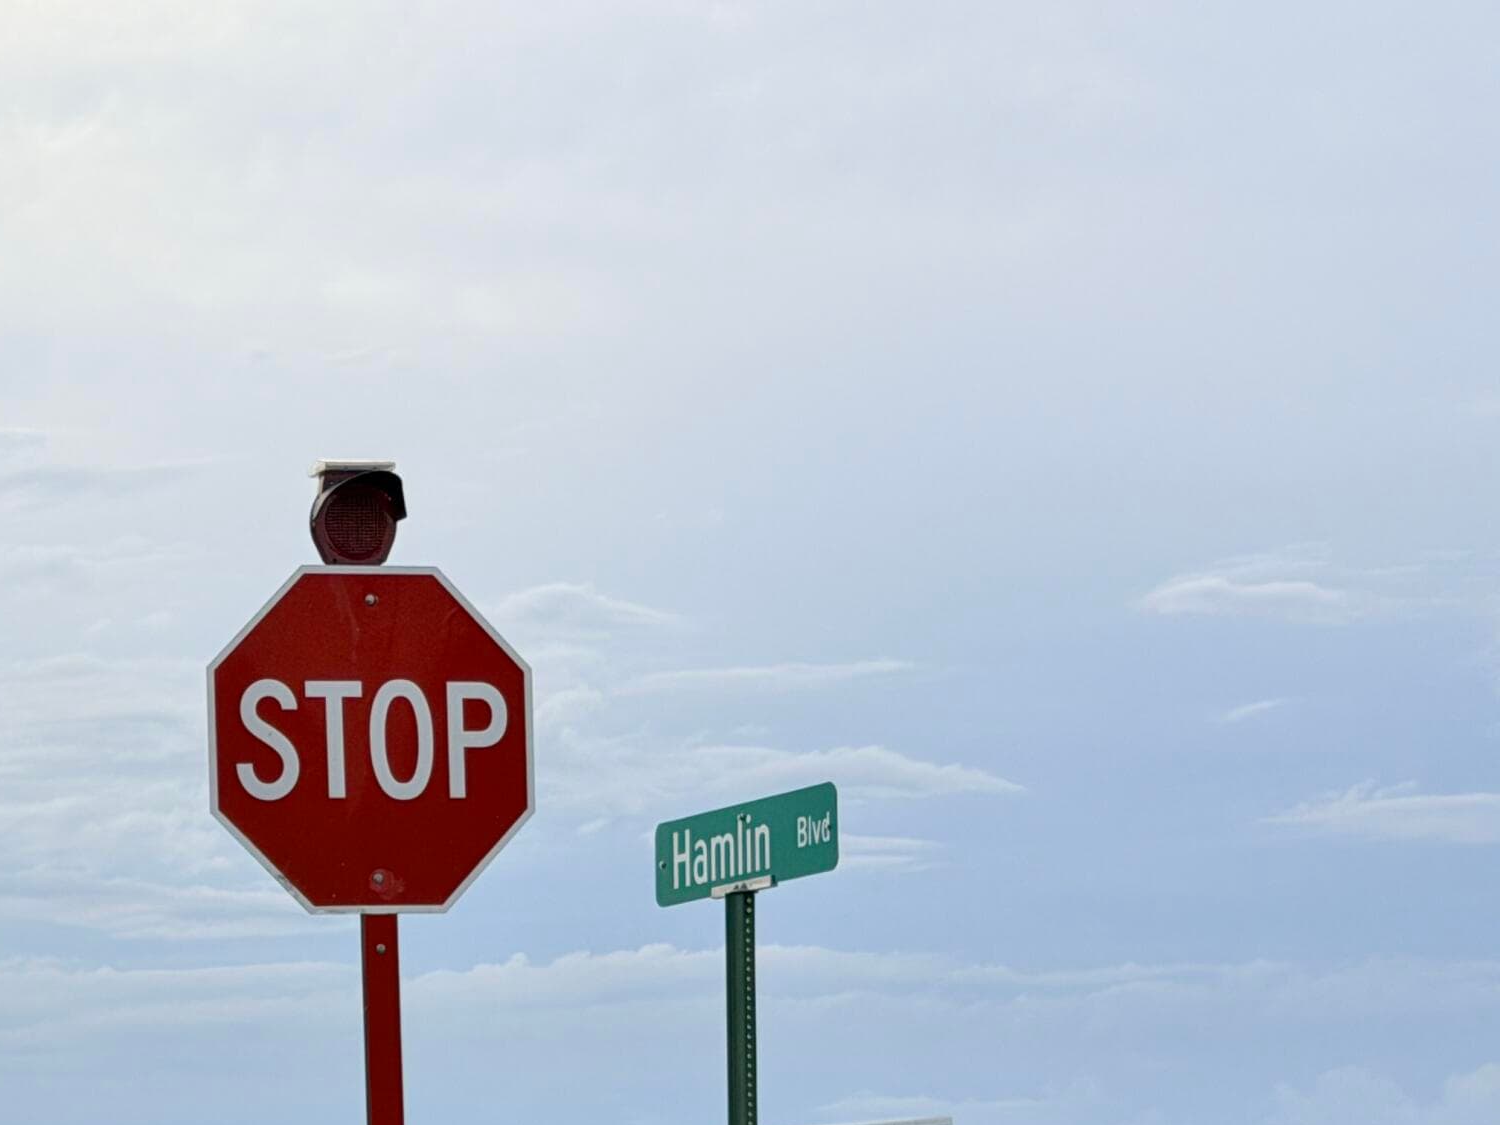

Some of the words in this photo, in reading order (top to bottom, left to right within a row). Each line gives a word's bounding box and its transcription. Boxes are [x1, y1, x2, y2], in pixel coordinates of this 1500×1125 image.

[235, 678, 508, 801] STOP
[672, 813, 771, 890] Hamlin
[796, 811, 831, 849] Blvd
